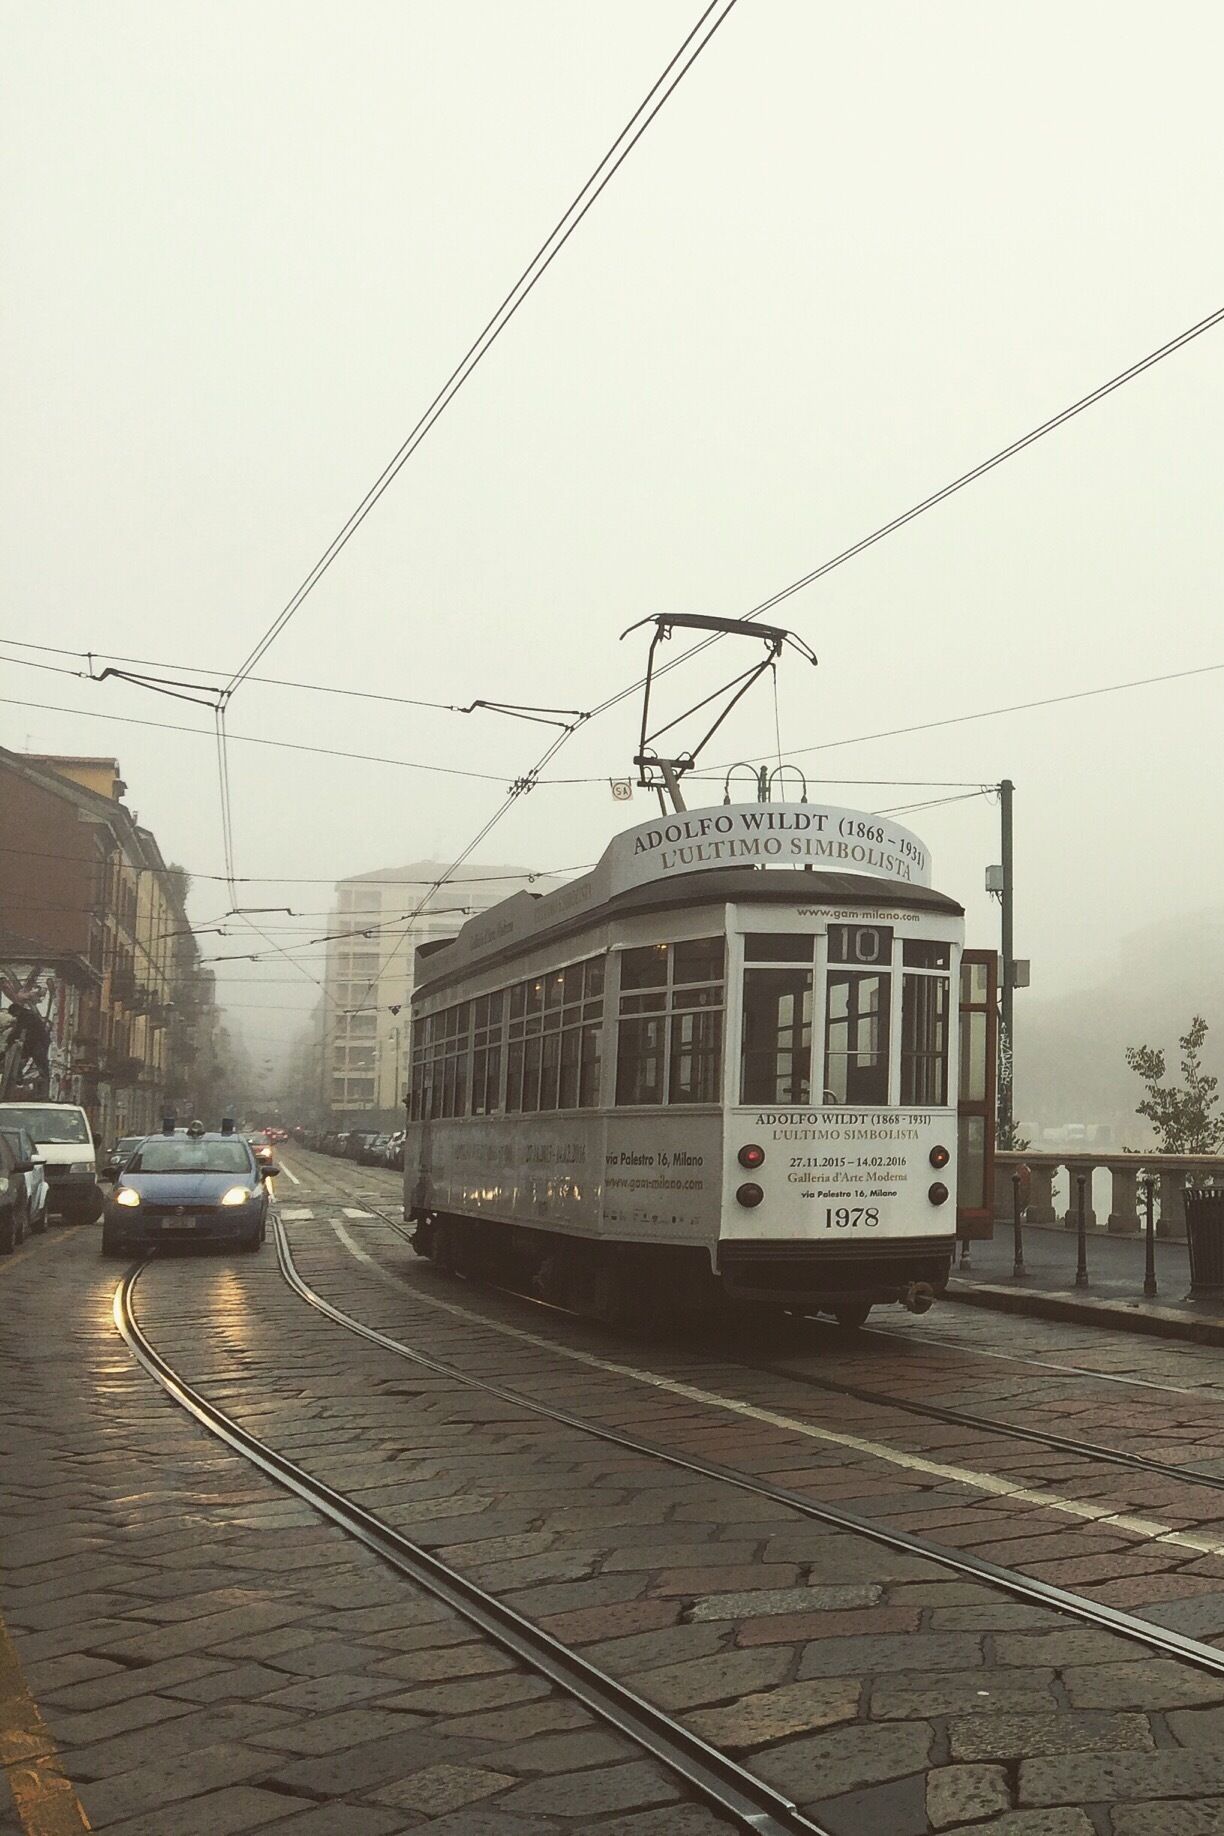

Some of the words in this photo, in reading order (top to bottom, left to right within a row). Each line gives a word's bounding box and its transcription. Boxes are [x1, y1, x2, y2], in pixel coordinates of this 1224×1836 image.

[634, 815, 733, 856] ADOLFO
[740, 812, 829, 832] WILDT
[838, 817, 885, 844] (1868
[899, 838, 925, 871] 1931)
[660, 837, 782, 870] L'ULTIMO
[790, 837, 912, 881] SIMBOLISTA
[841, 927, 880, 961] 10
[755, 1113, 818, 1125] ADOLFO
[822, 1113, 869, 1125] WILDT
[773, 1129, 841, 1140] L'ULTIMO
[844, 1129, 919, 1140] SIMBOLISTA
[605, 1151, 619, 1166] via
[620, 1151, 655, 1166] Palestro
[673, 1151, 704, 1167] Milano
[789, 1156, 846, 1168] 27.11.2015
[856, 1155, 907, 1167] 14.02.2016
[787, 1172, 831, 1183] Galleria
[832, 1171, 864, 1182] d'Arte
[801, 1190, 815, 1199] via
[817, 1190, 852, 1199] Palestro
[869, 1188, 898, 1198] Milano
[825, 1207, 880, 1229] 1978
